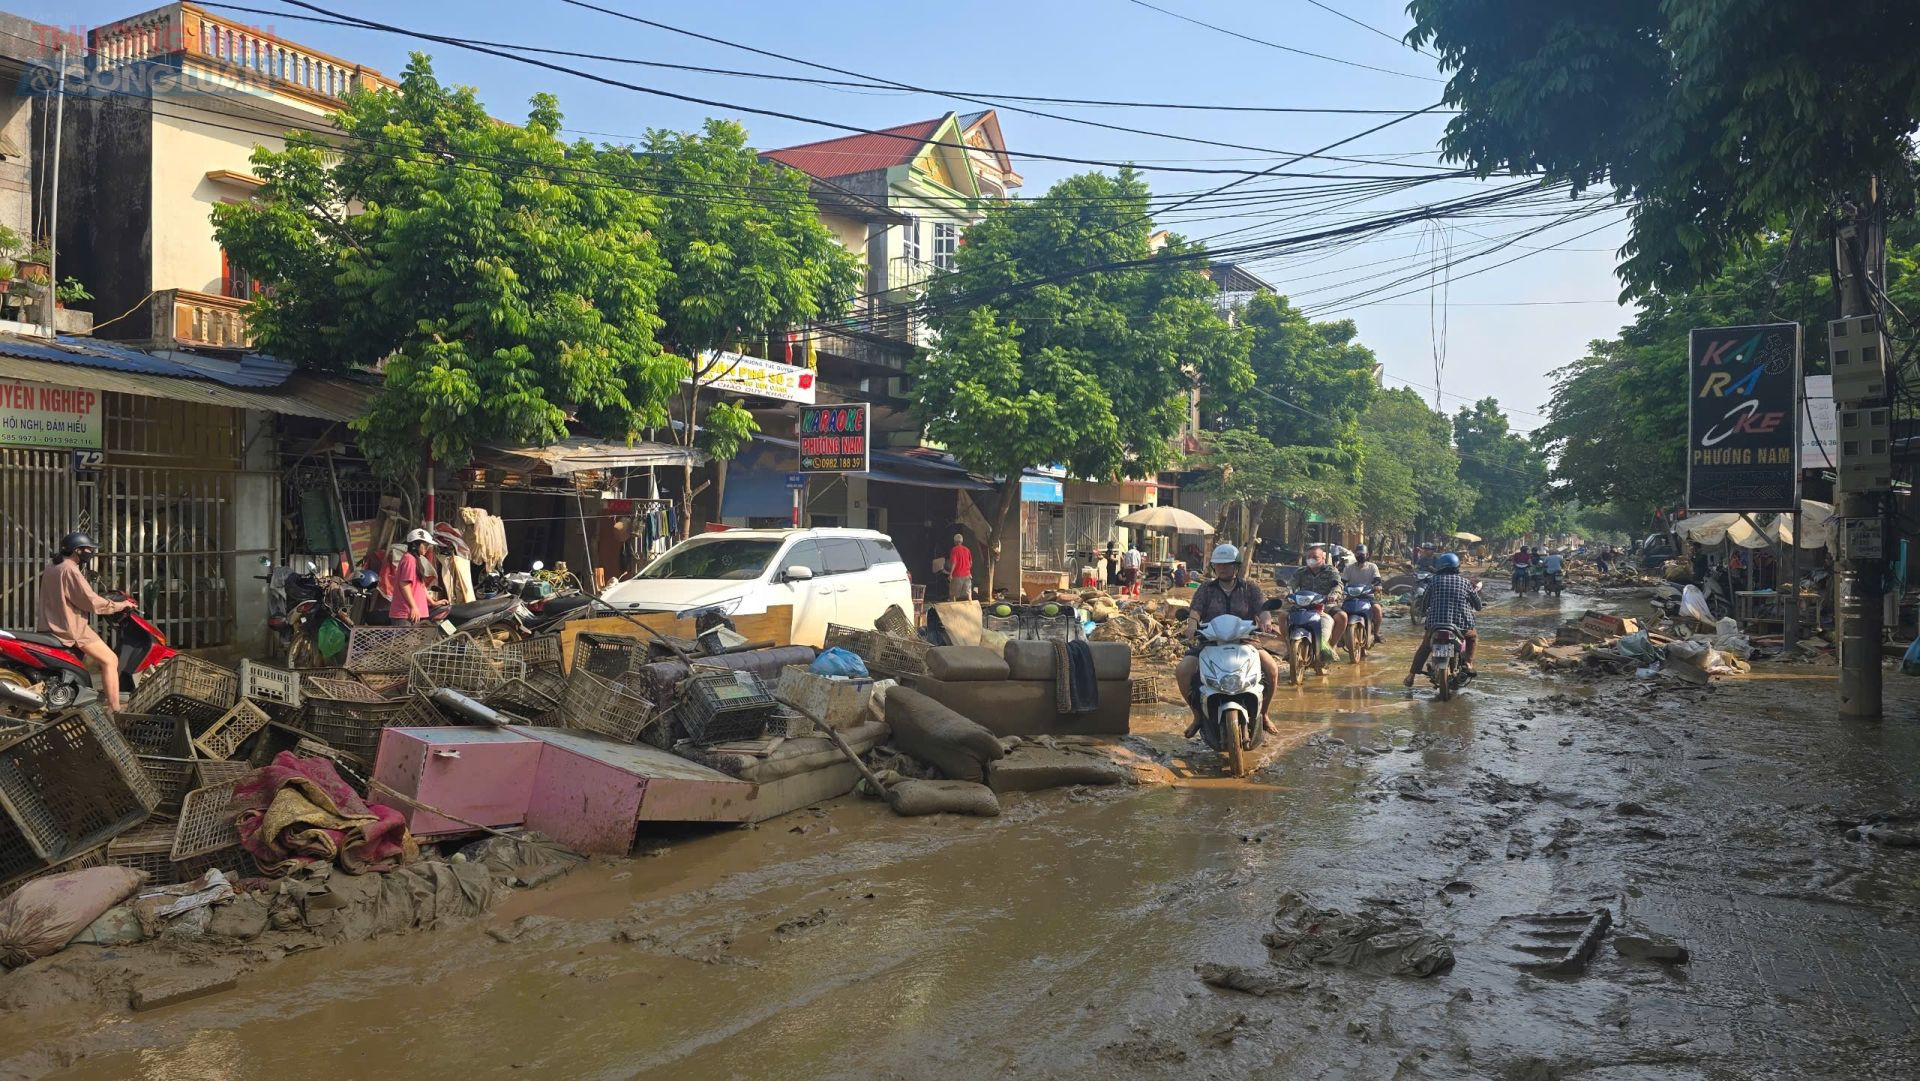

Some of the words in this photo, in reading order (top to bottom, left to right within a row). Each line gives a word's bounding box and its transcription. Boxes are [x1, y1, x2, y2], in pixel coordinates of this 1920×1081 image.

[40, 386, 95, 420] NGHIỆP
[803, 407, 865, 432] KARAOKE
[841, 436, 864, 454] NAM
[76, 451, 104, 469] 72
[821, 457, 838, 468] 0982
[840, 457, 851, 468] 188
[1758, 448, 1790, 464] NAM
